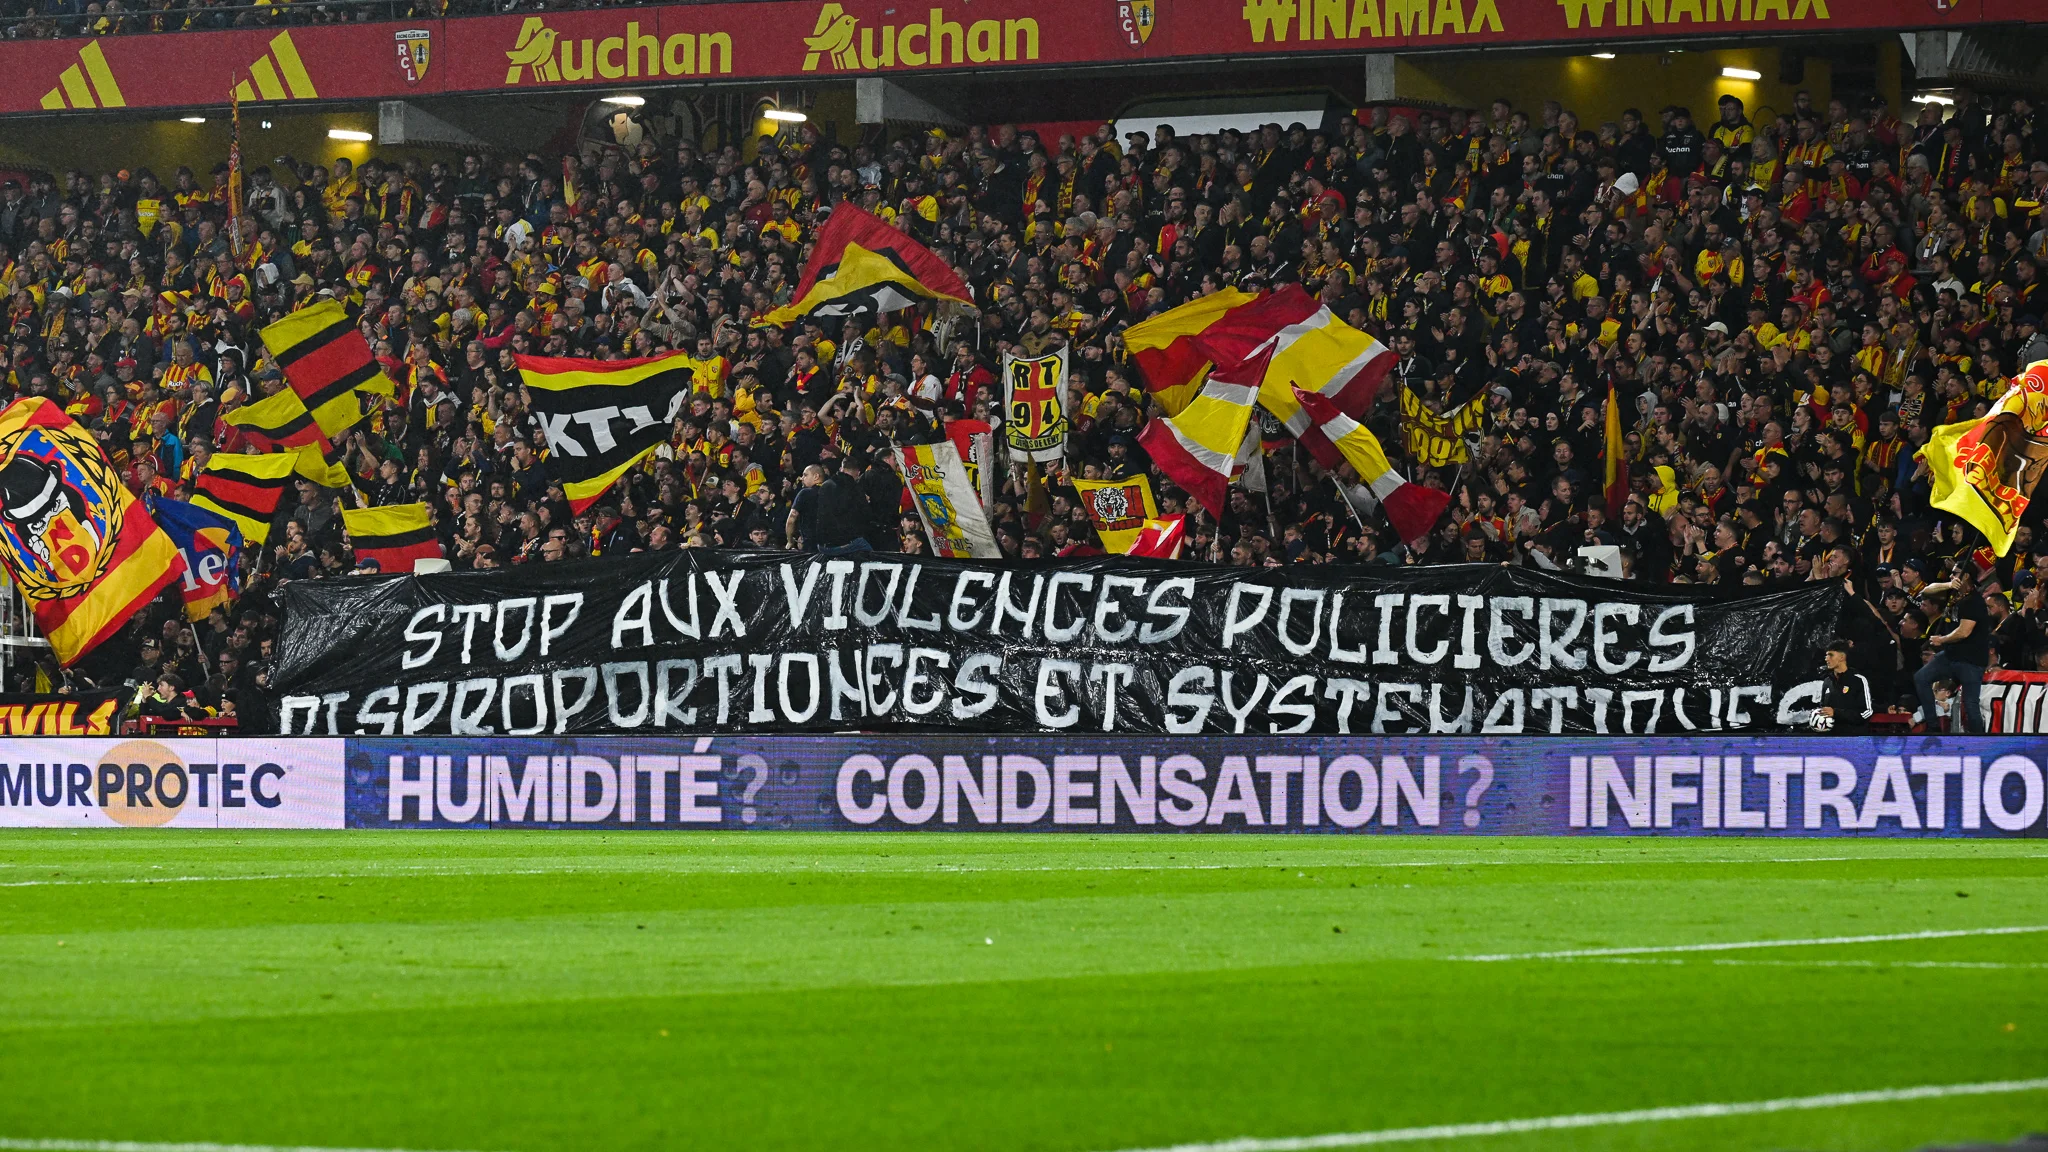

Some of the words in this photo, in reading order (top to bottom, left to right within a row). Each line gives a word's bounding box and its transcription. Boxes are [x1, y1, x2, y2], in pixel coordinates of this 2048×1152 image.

[505, 16, 732, 84] Auchan
[802, 3, 1039, 71] Auchan
[1243, 0, 1504, 43] WINAMAX
[1013, 401, 1054, 428] 94
[402, 593, 583, 669] STOP
[612, 569, 746, 647] AUX
[781, 560, 1195, 644] VIOLENCES
[1223, 582, 1695, 674] POLICIERES
[280, 643, 1003, 733] DISPROPORTIONEES
[1034, 658, 1134, 732] ET
[0, 763, 286, 808] MURPROTEC
[388, 736, 722, 823] HUMIDITÉ
[836, 754, 1441, 827] CONDENSATION
[1458, 754, 1494, 828] ?
[1569, 754, 2048, 830] INFILTRATIO
